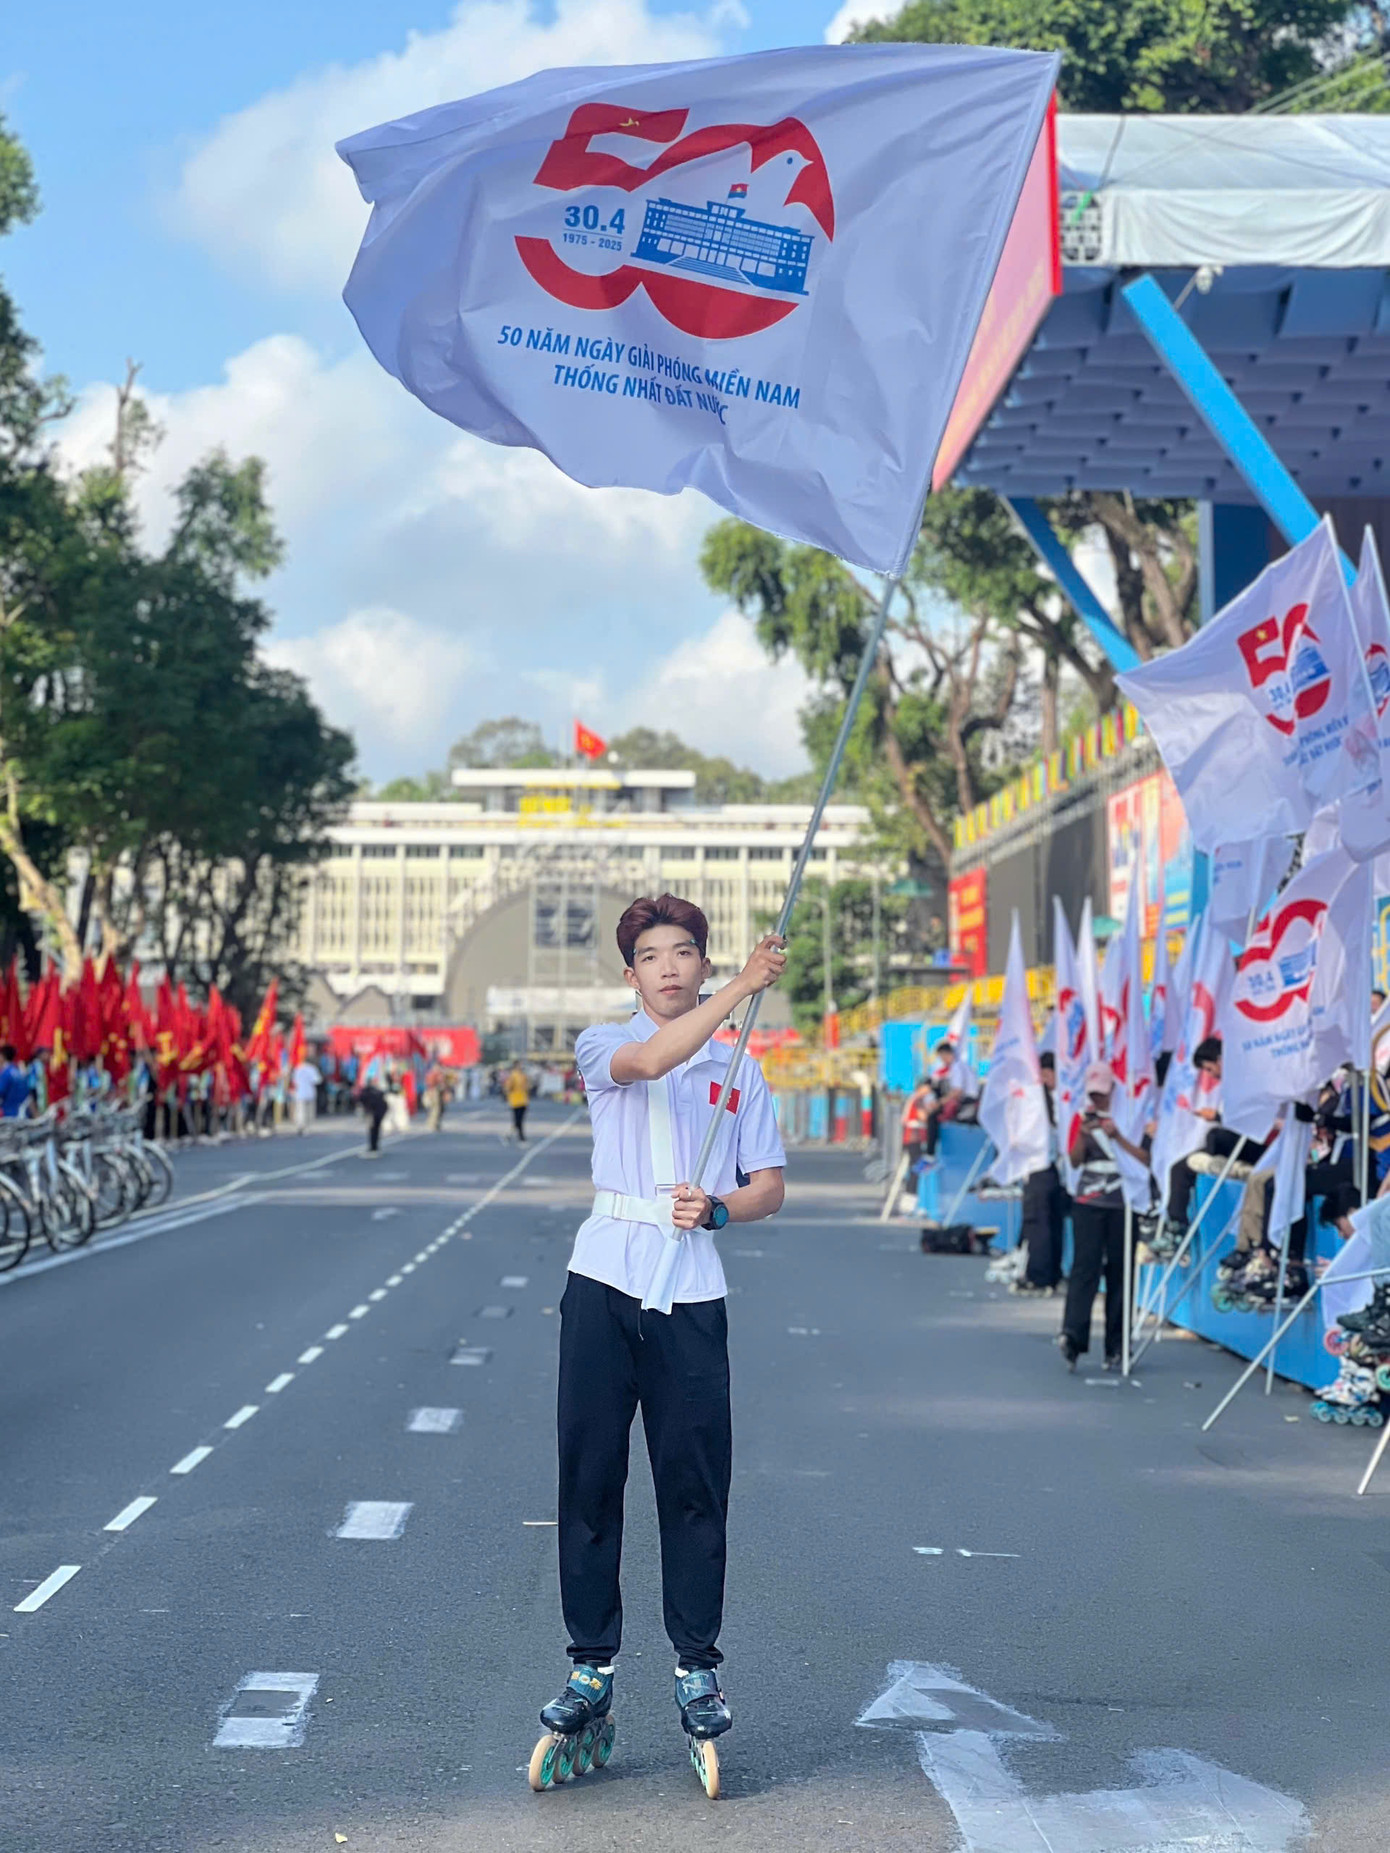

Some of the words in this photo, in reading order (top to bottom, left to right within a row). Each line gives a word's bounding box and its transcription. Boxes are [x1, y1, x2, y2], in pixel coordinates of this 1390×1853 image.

[564, 205, 625, 235] 30.4
[563, 233, 588, 246] 1975
[598, 237, 623, 252] 2025
[498, 325, 523, 347] 50
[526, 327, 571, 355] NĂM
[574, 337, 626, 364] NGÀY
[628, 343, 654, 371] GIẢI
[657, 356, 702, 384] PHÓNG
[704, 368, 751, 398] MIỀN
[755, 380, 801, 409] NAM
[554, 364, 620, 394] THỐNG
[623, 376, 662, 403] NHẤT
[665, 384, 693, 408] ĐẤT
